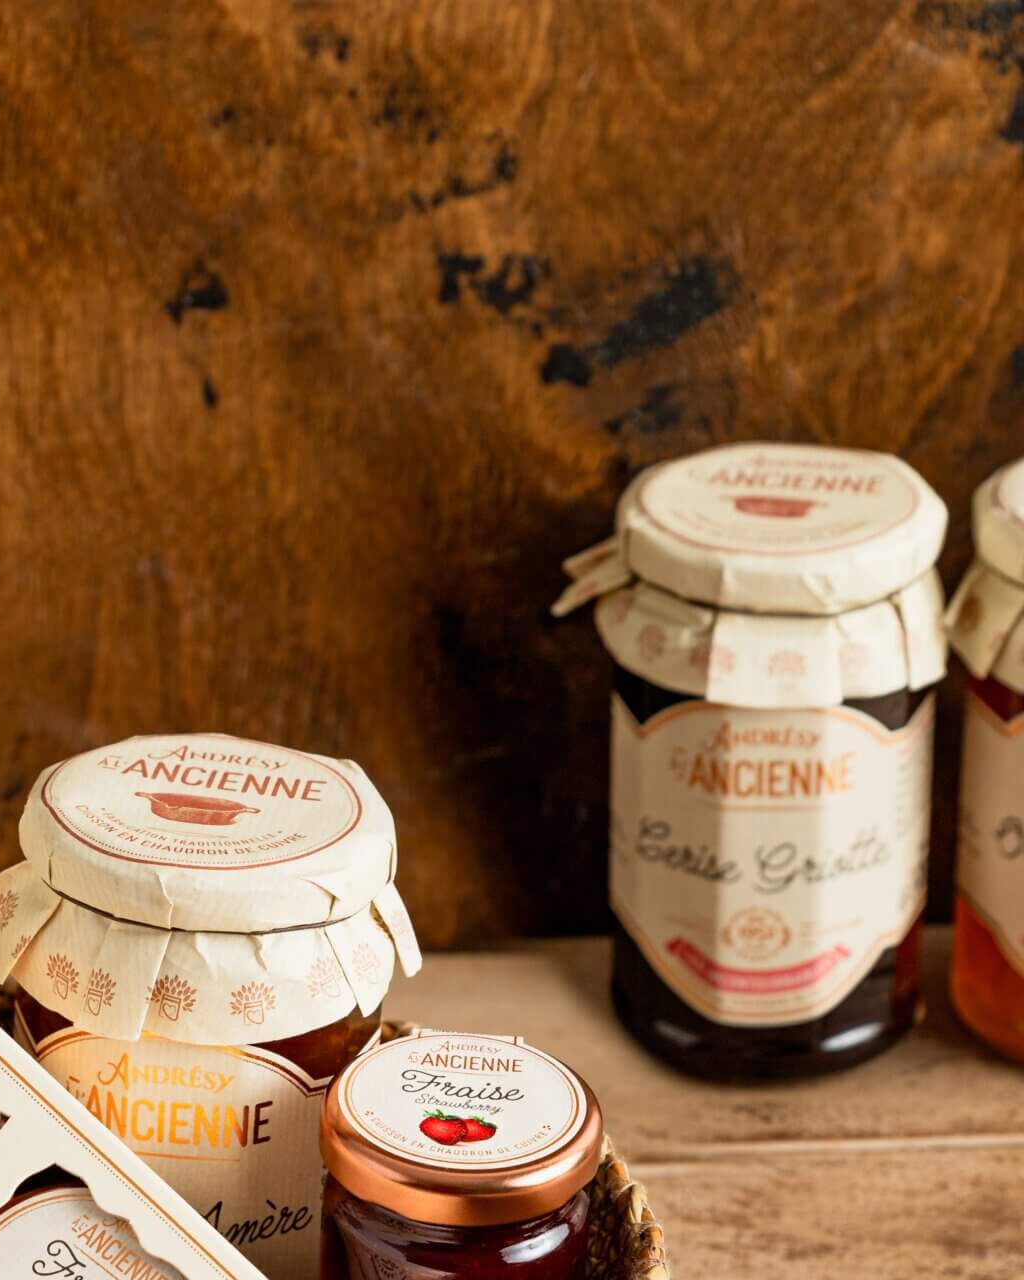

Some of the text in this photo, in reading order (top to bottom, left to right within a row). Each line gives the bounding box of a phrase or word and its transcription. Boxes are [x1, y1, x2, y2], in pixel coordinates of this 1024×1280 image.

[118, 831, 139, 844] EN
[140, 840, 229, 855] CHAUDRON
[234, 845, 253, 855] DE
[257, 832, 308, 852] CUIVRE
[97, 1052, 237, 1093] ANDRÉSY
[401, 1069, 525, 1102] Fraise
[414, 1092, 505, 1115] Strawberry
